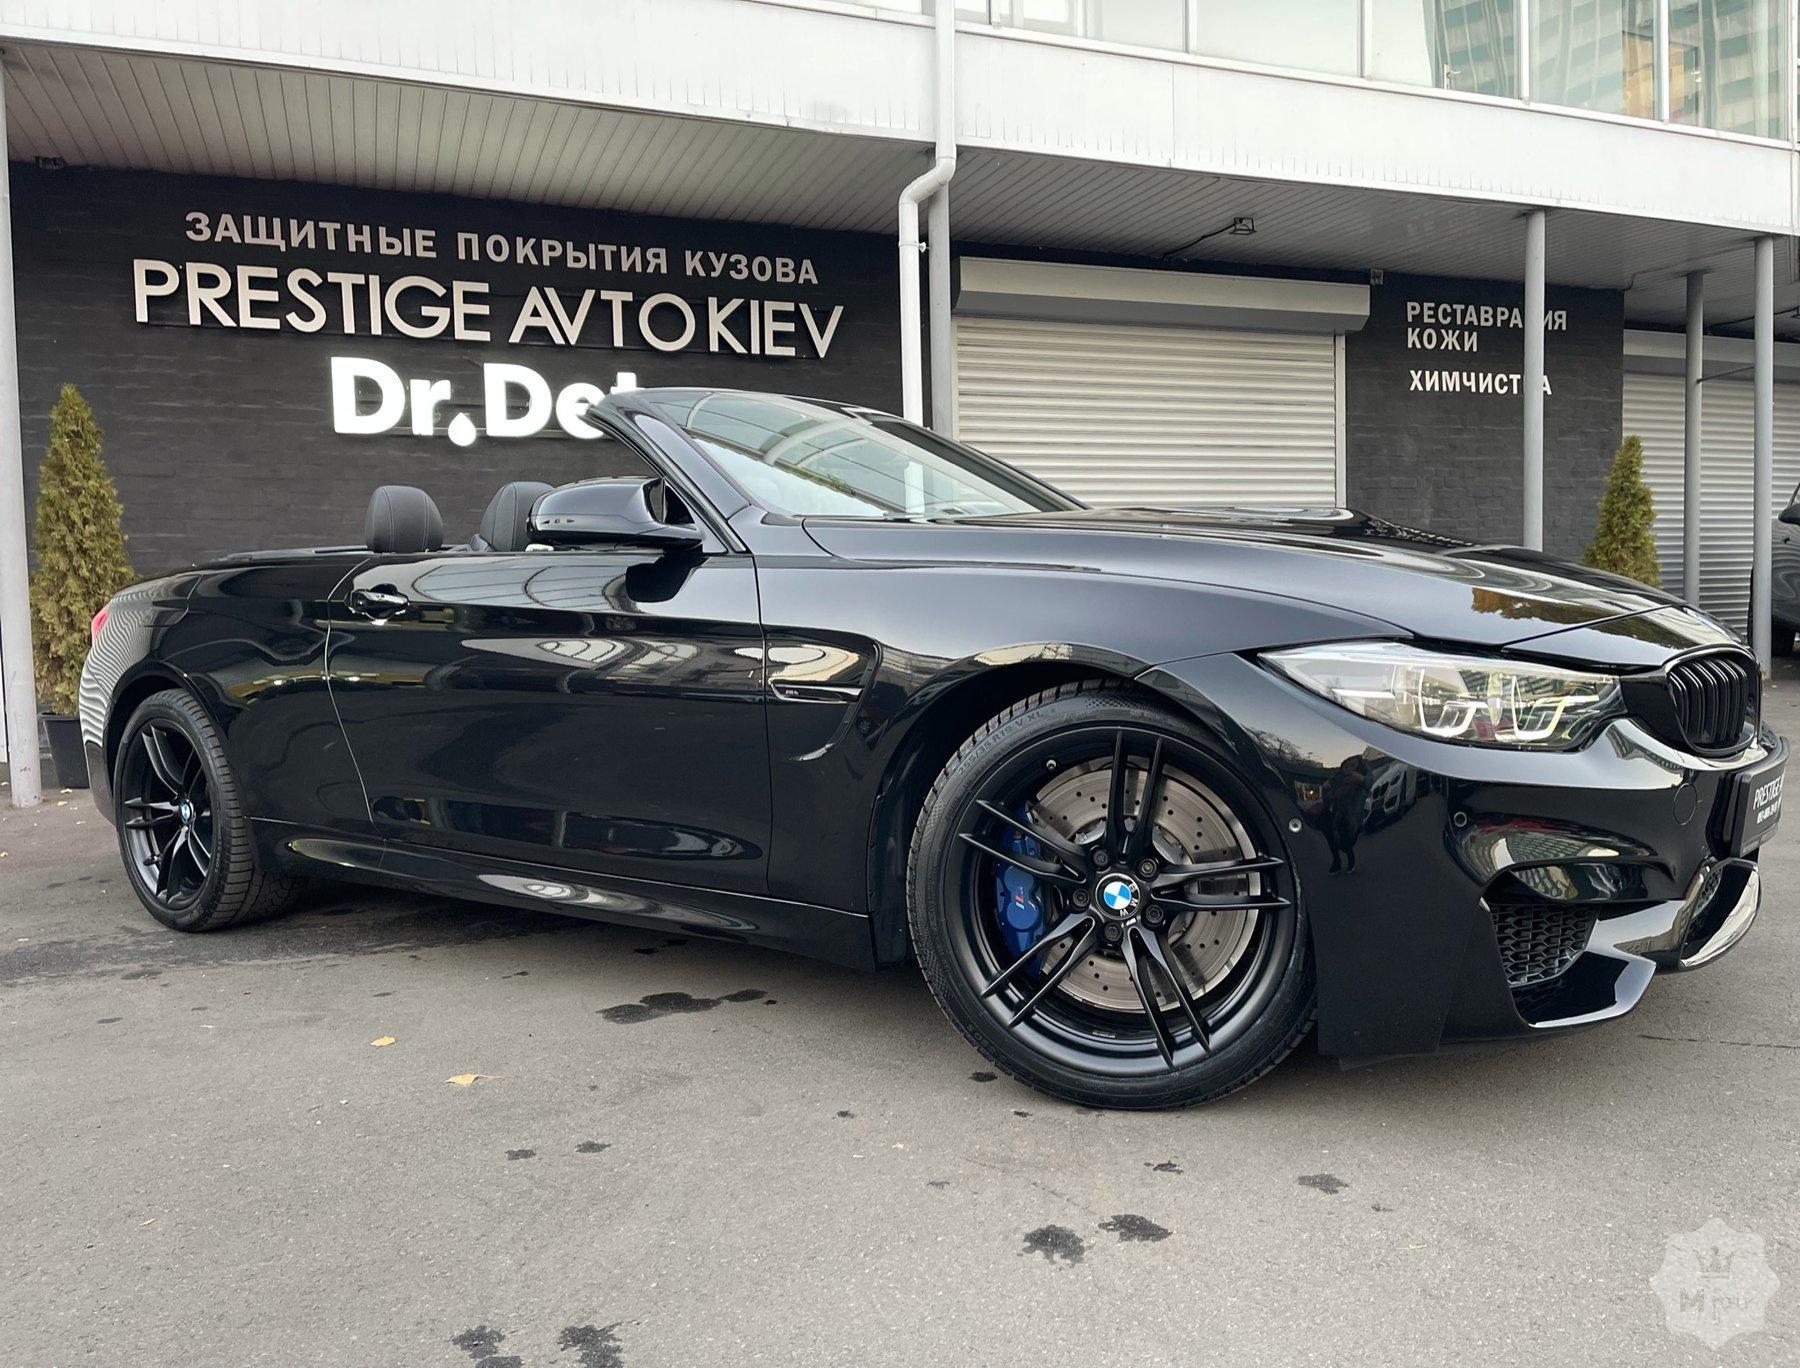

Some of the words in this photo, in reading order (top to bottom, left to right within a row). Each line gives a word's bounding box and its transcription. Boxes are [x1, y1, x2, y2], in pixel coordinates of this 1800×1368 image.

[185, 211, 437, 259] ЗАЩИТНЫЕ
[457, 232, 668, 274] ПОКРЫТИЯ
[685, 250, 818, 285] КУЗОВА
[133, 258, 491, 342] PRESTIGE
[1406, 301, 1567, 331] РЕСТАВРАИЯ
[1407, 327, 1478, 352] КОЖИ
[1409, 369, 1552, 395] ХИМЧИСТА
